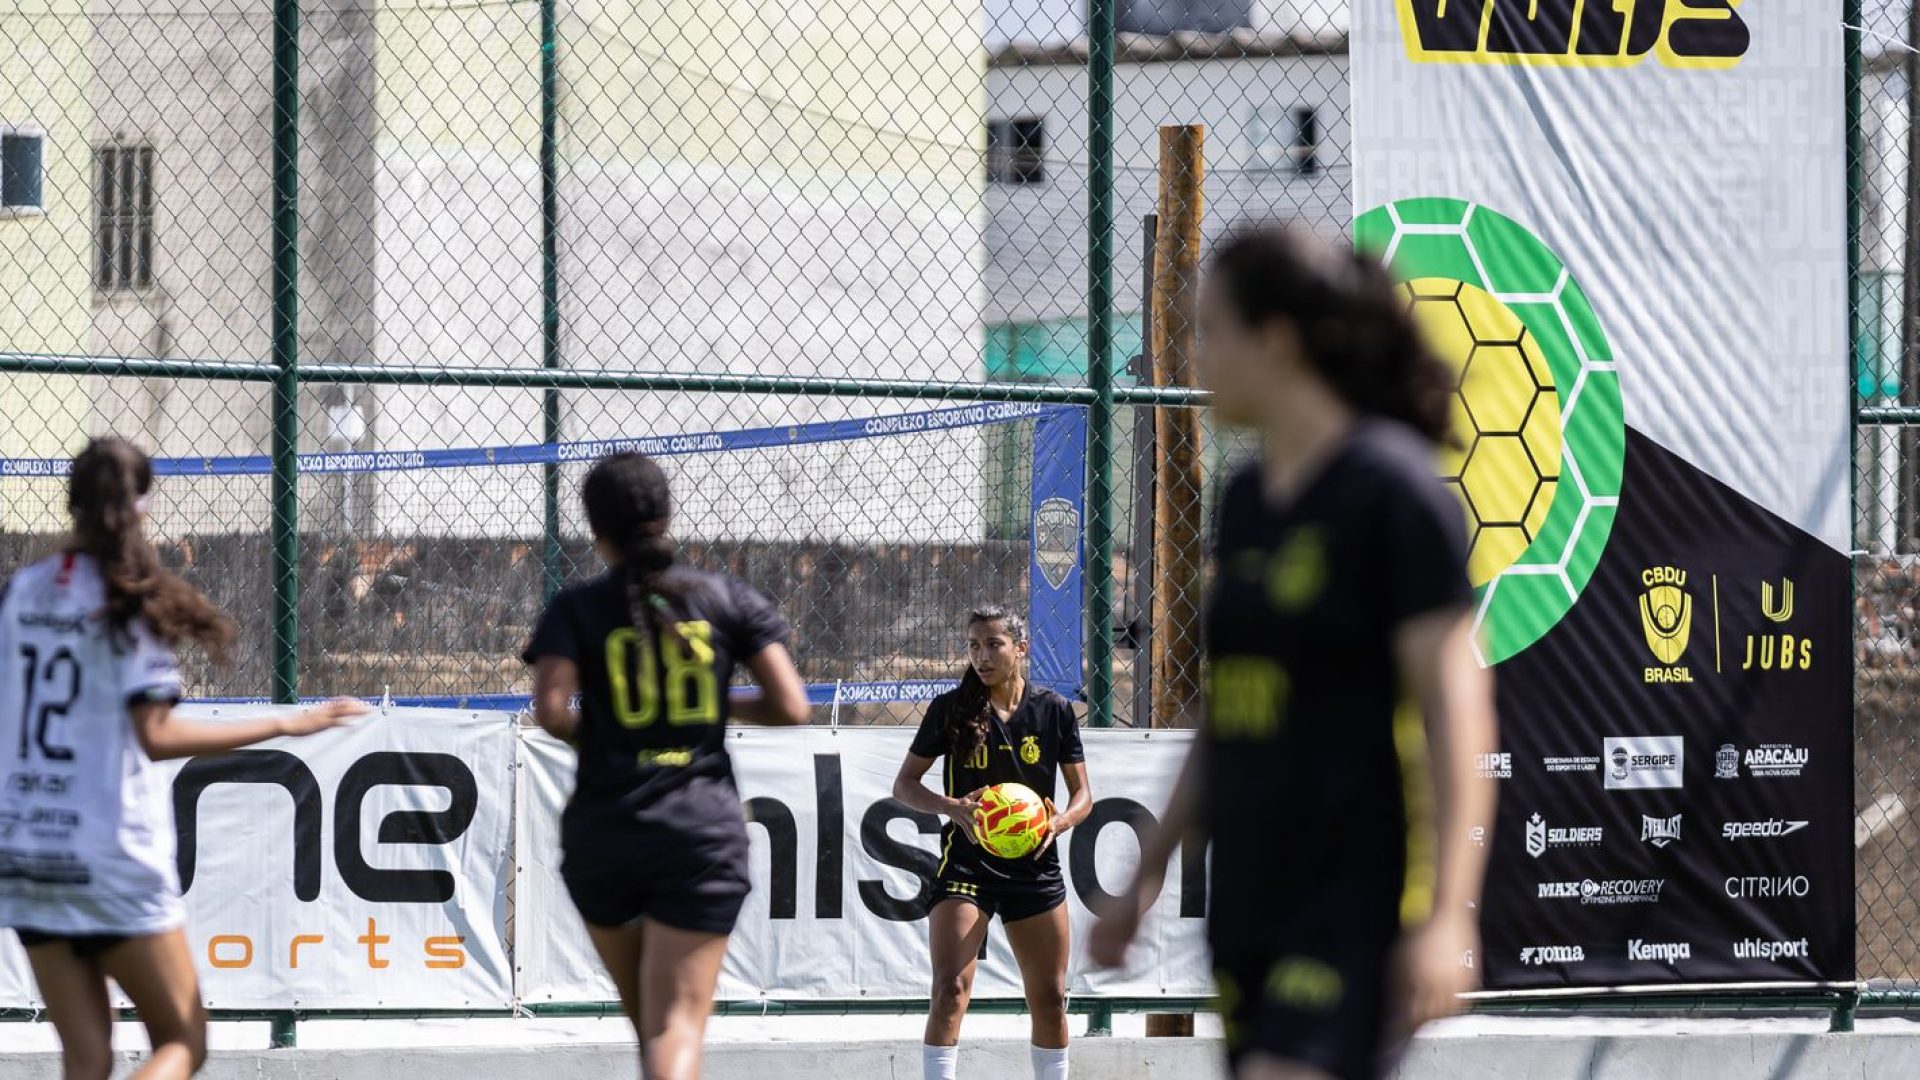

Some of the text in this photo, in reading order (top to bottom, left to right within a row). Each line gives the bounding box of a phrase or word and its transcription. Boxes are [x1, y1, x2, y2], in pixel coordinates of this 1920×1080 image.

[865, 415, 925, 434] COMPLEXO
[928, 407, 984, 428] ESPORTIVO
[558, 443, 613, 460] COMPLEXO
[3, 460, 51, 475] COMPLEXO
[325, 454, 374, 471] ESPORTIVO
[1642, 566, 1686, 586] CBDU
[1743, 635, 1812, 669] JUBS
[1645, 667, 1694, 683] BRASIL
[839, 683, 897, 700] COMPLEXO
[20, 643, 81, 761] 12
[1474, 753, 1512, 770] GIPE
[1631, 754, 1675, 766] SERGIPE
[1744, 748, 1809, 765] ARACAJU
[172, 749, 478, 903] ne
[1549, 828, 1602, 842] SOLDIERS
[1641, 814, 1682, 842] EVERLAST
[1722, 818, 1783, 841] speedo
[1538, 880, 1665, 898] MAX RECOVERY
[208, 917, 465, 969] orts
[1628, 939, 1691, 965] Kempa
[1733, 938, 1808, 962] uhlsport
